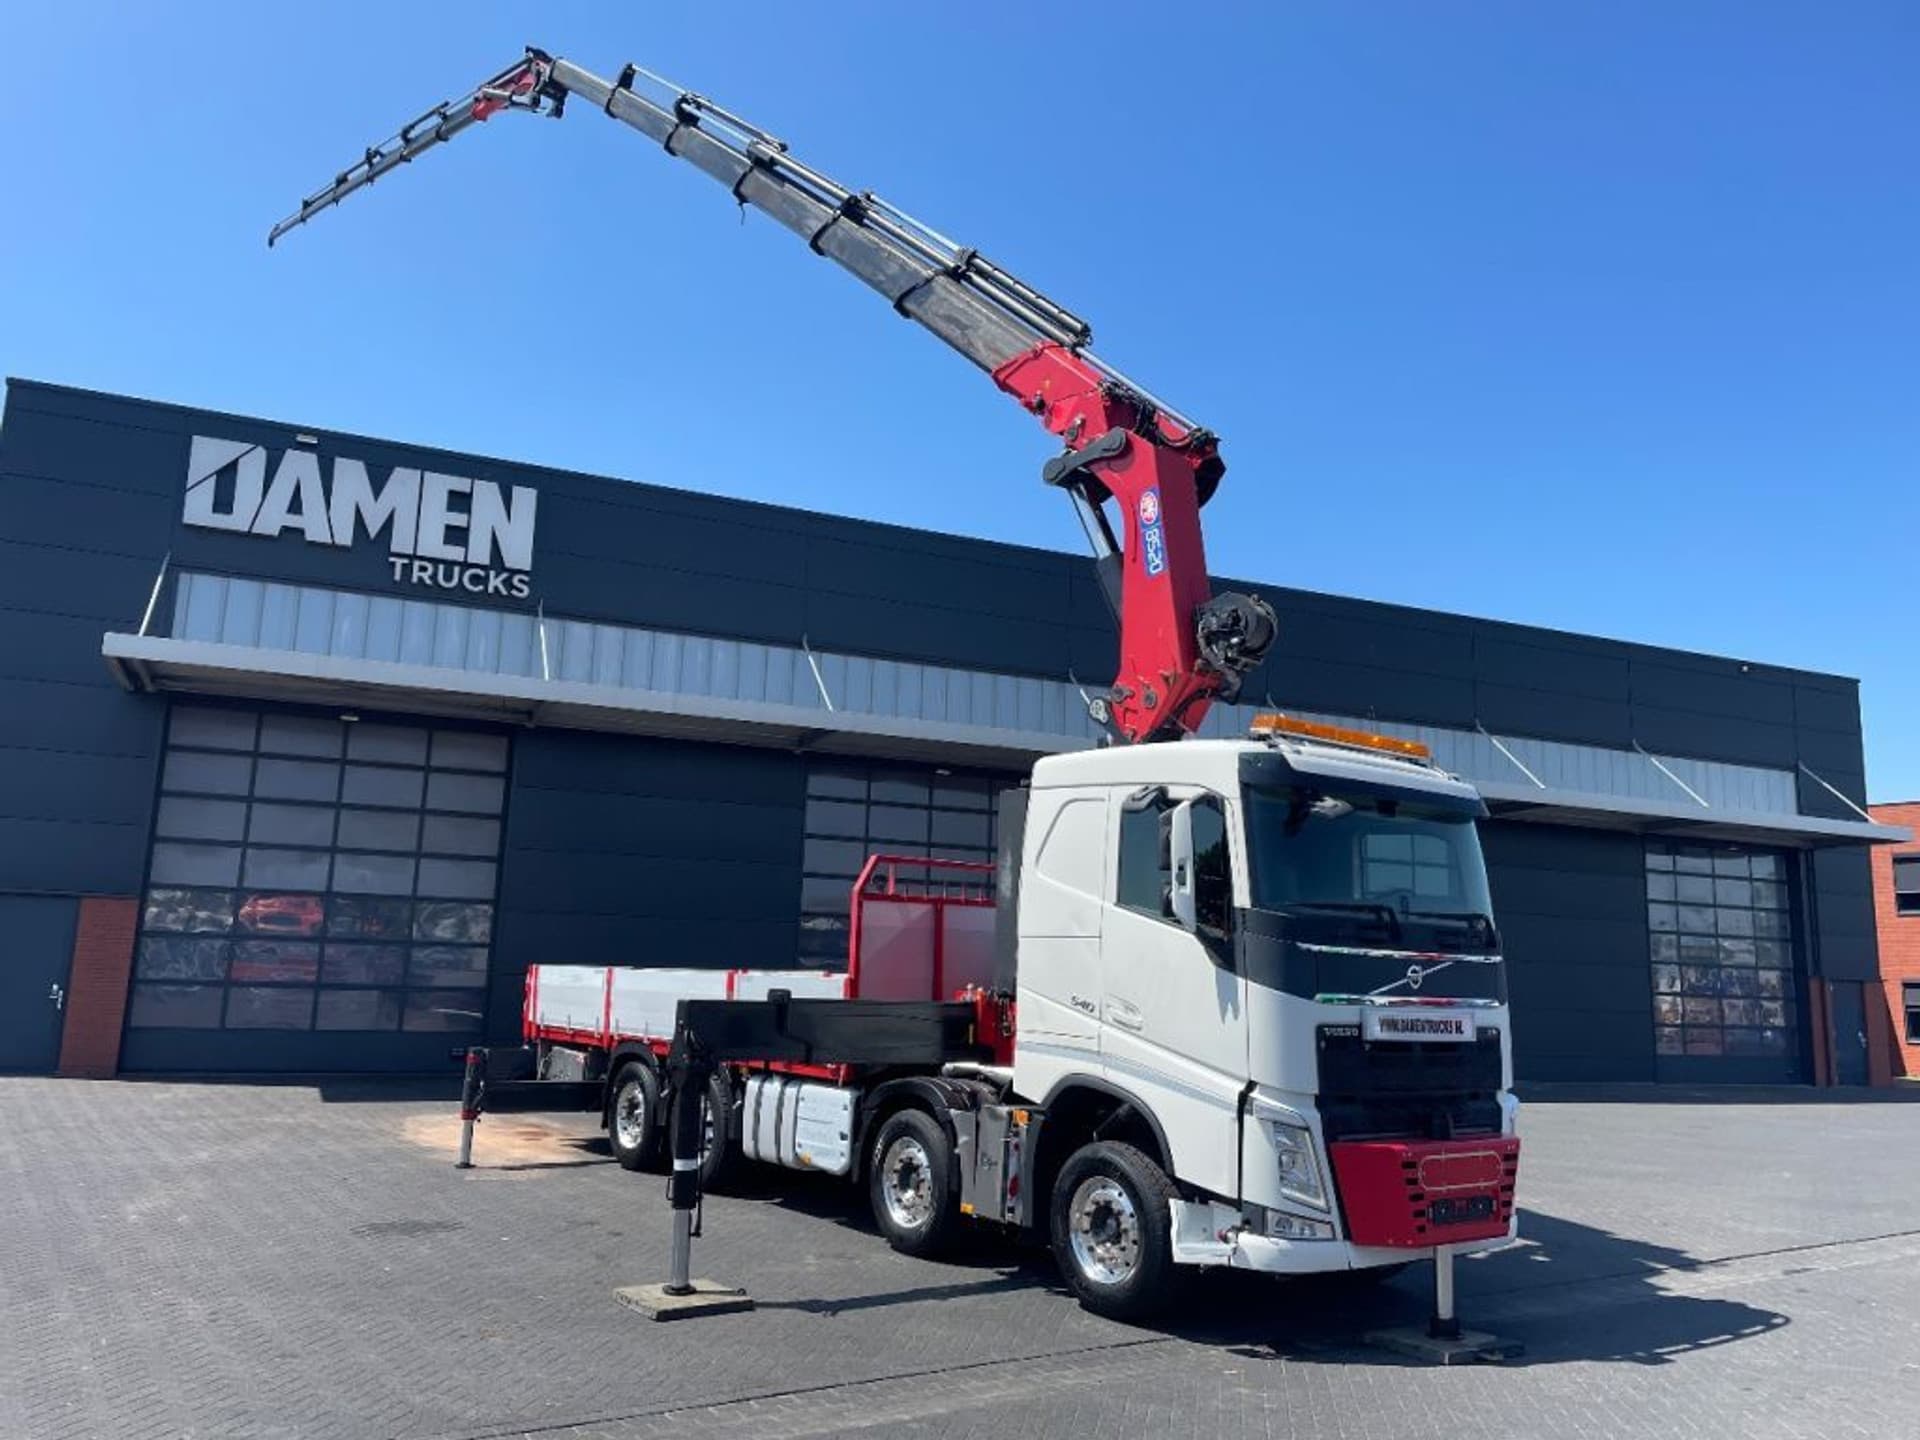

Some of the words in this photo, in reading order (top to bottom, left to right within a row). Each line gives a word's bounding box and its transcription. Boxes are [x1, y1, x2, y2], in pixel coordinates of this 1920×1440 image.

[182, 435, 537, 571] DAMEN
[388, 557, 531, 598] TRUCKS
[1323, 1026, 1359, 1037] VOLVO
